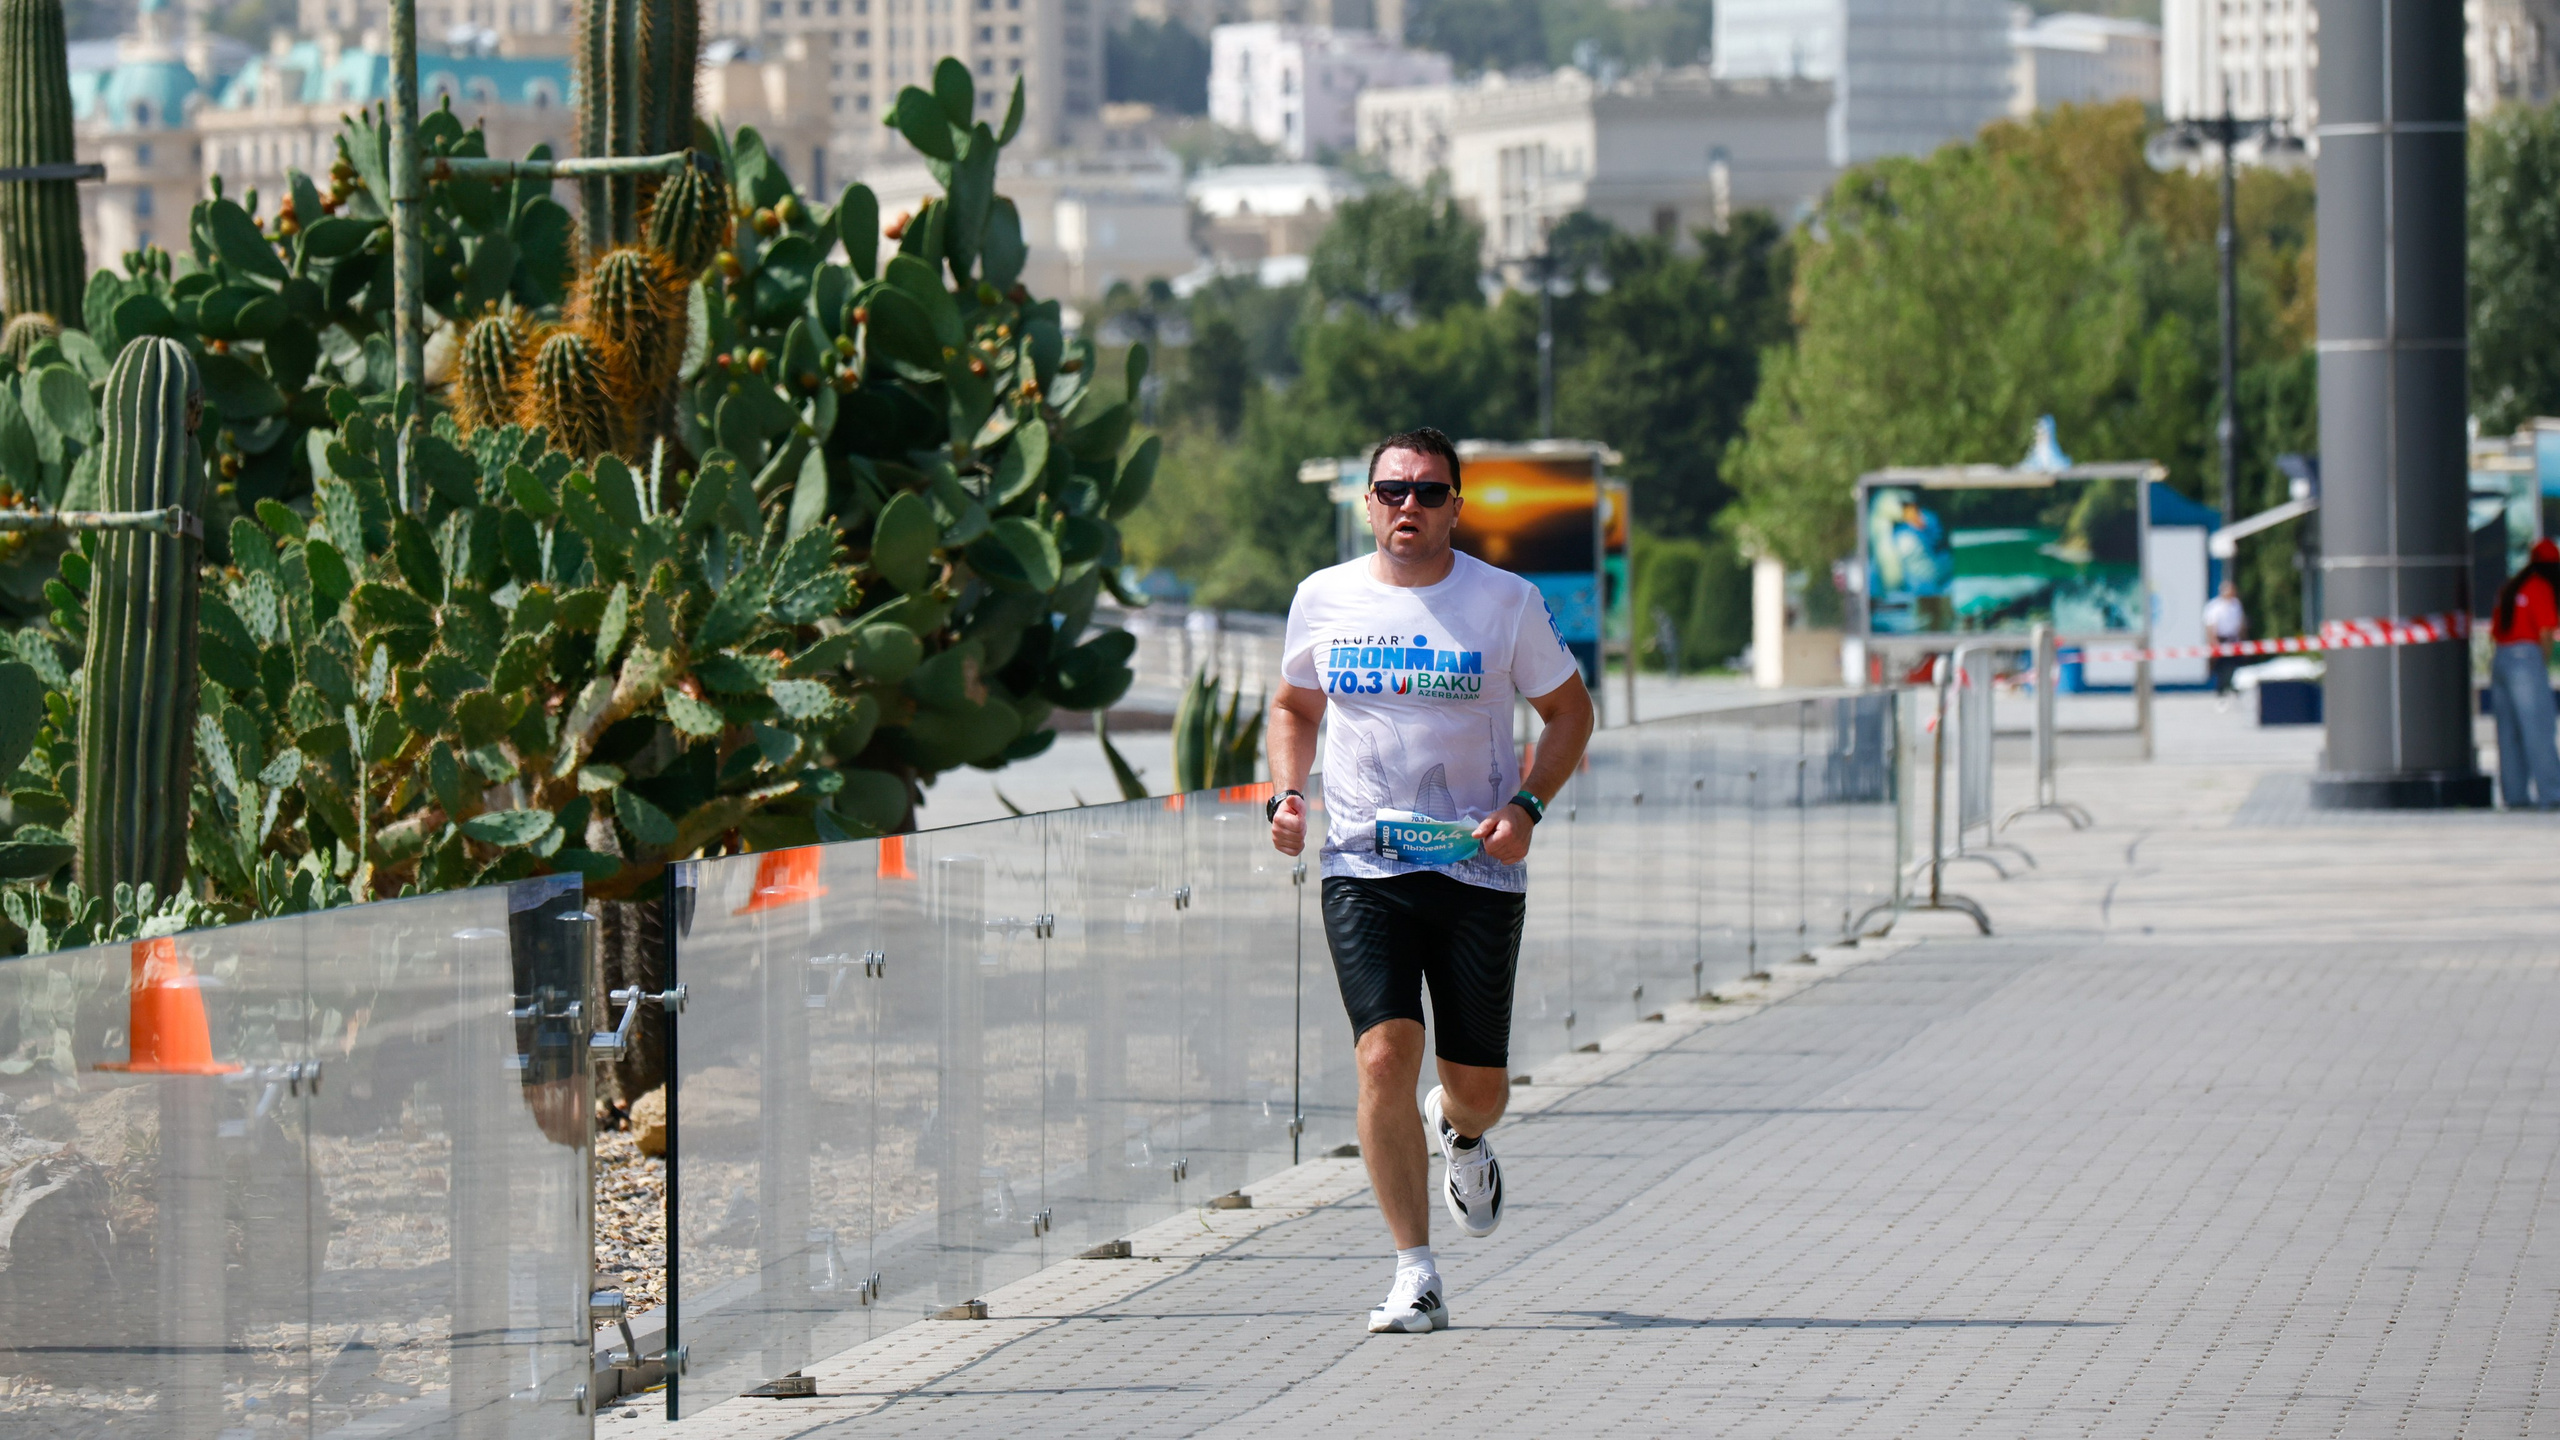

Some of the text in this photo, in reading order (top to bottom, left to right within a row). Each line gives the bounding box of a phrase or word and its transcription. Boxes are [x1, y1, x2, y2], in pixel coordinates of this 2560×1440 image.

[1329, 646, 1482, 674] IRONMAN
[1327, 671, 1481, 694] 70.3 BAKU
[1417, 689, 1480, 700] AZERBAIJAN
[1395, 829, 1463, 844] 10044
